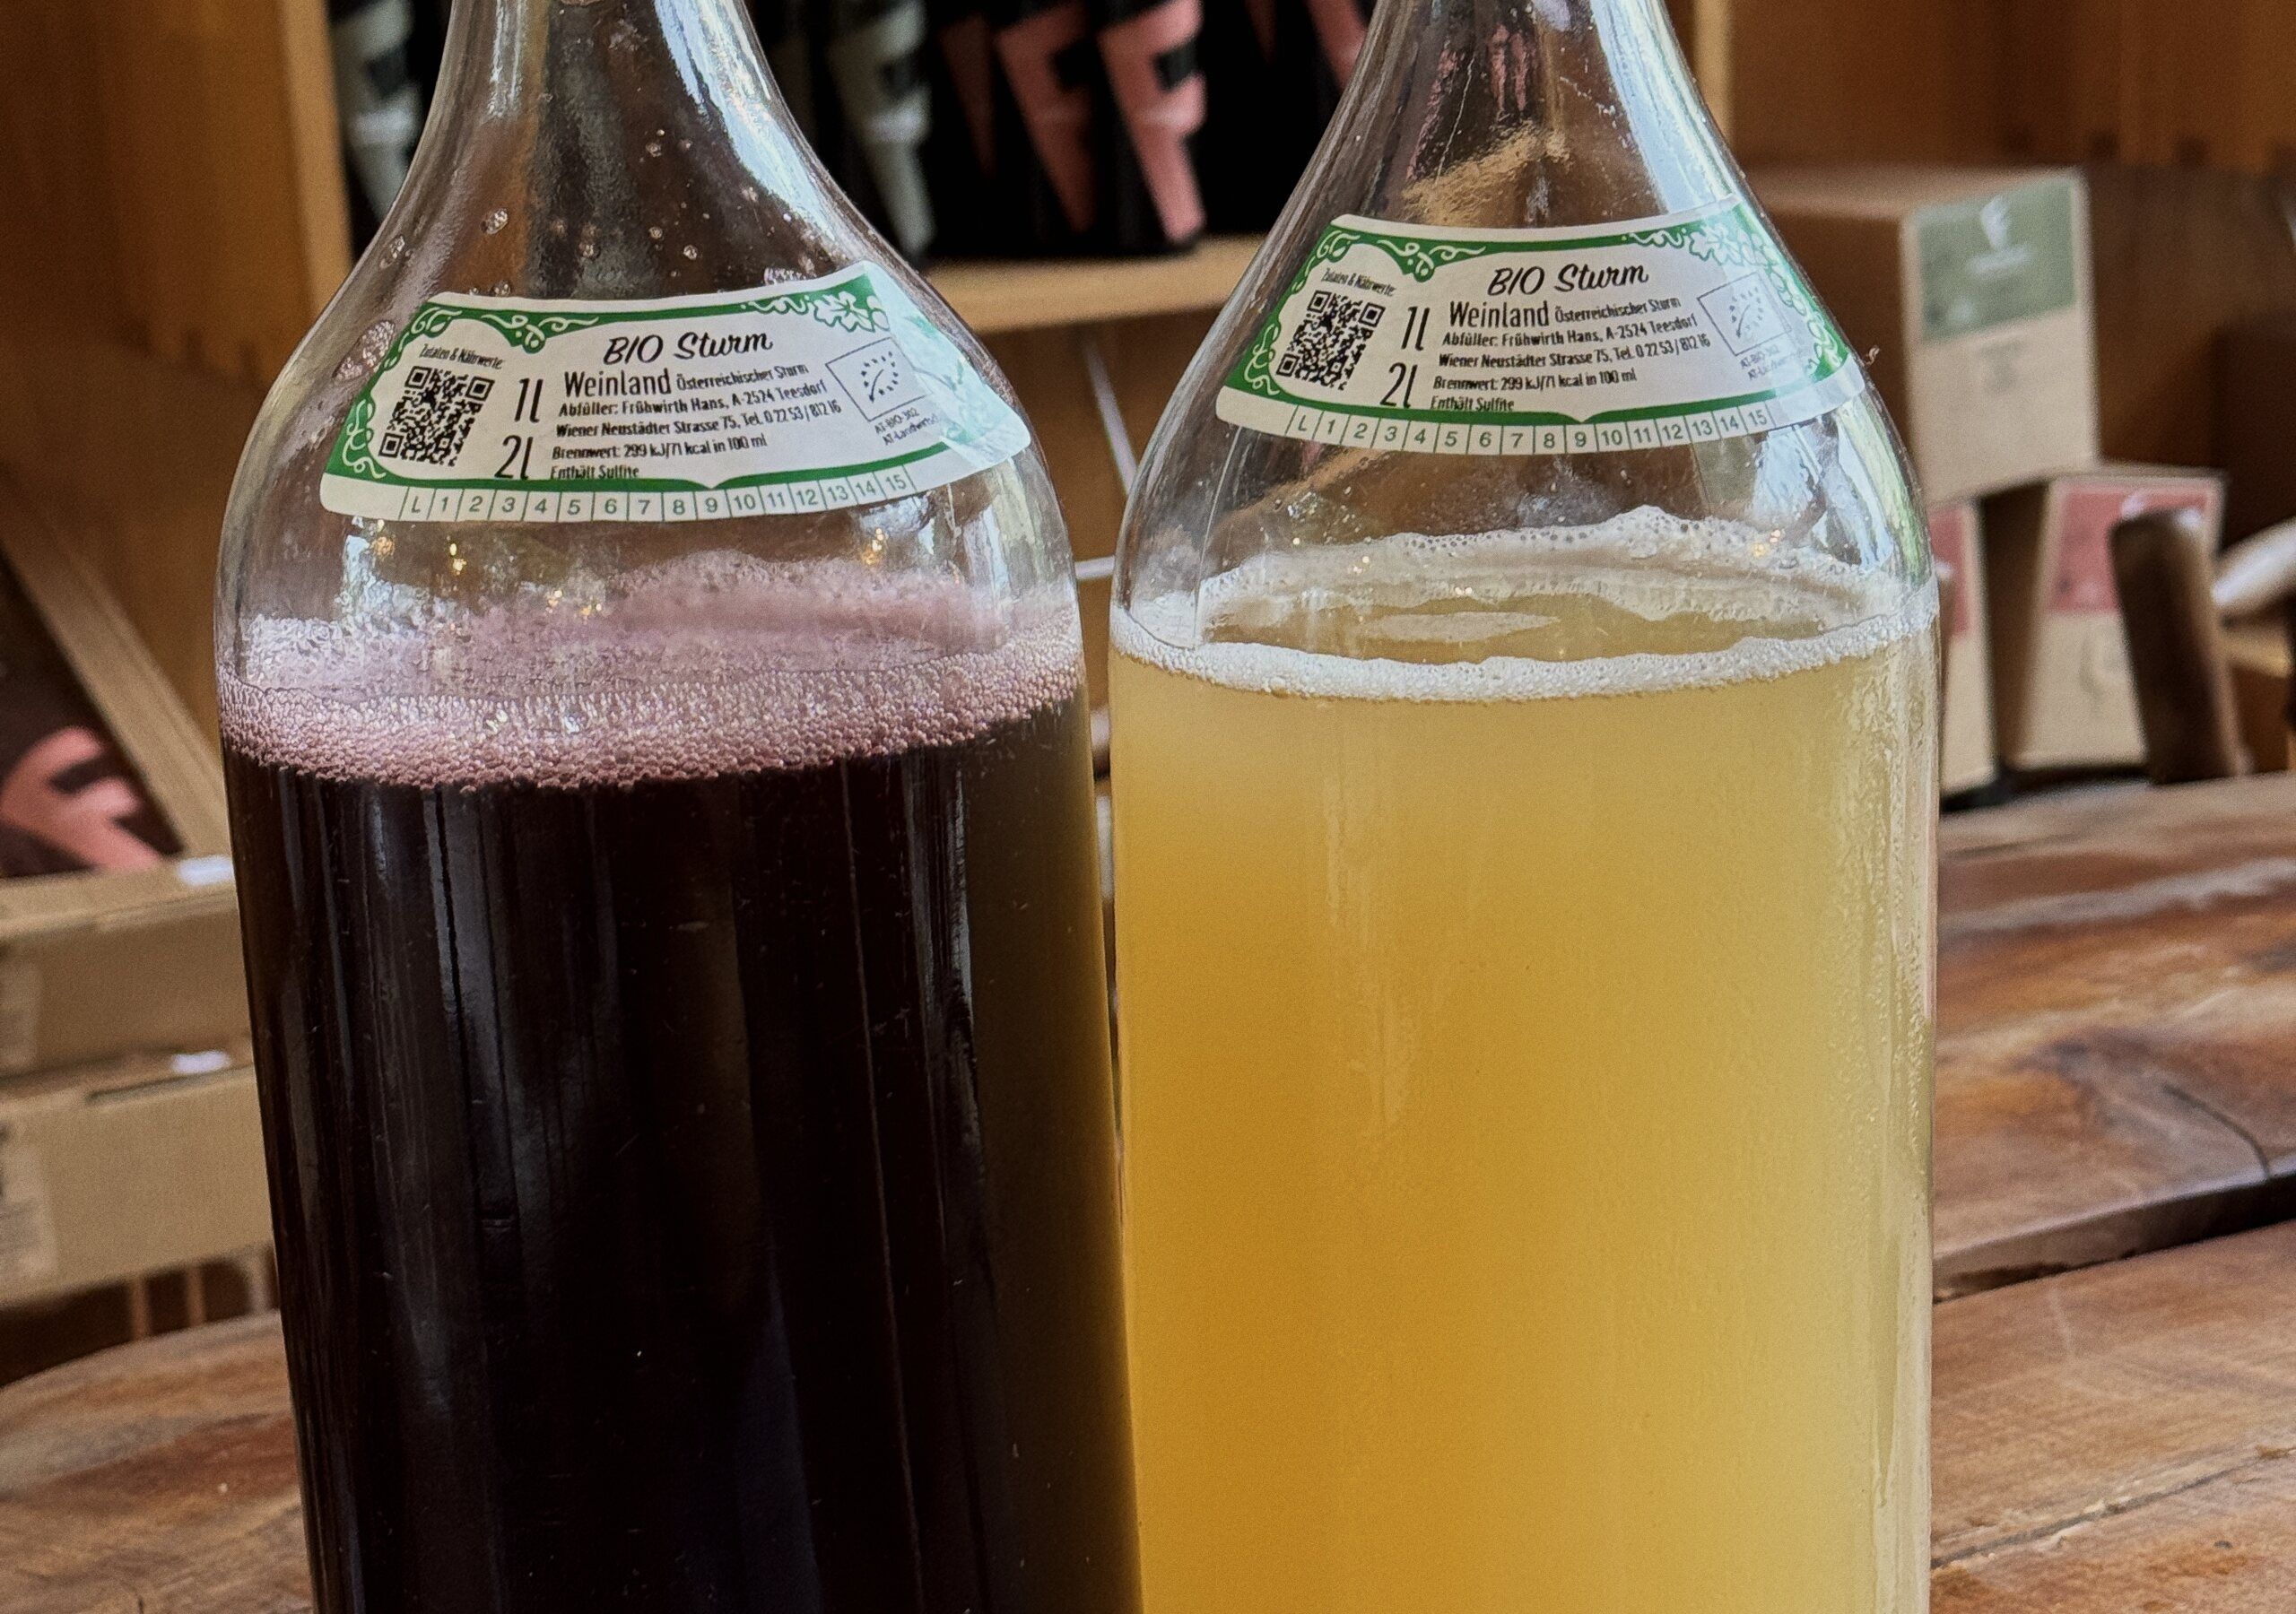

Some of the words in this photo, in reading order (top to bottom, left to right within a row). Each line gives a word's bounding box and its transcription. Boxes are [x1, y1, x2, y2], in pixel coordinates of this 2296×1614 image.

[1487, 265, 1545, 296] BIO
[1554, 263, 1649, 292] Sturm
[1449, 299, 1550, 328] Weinland
[1554, 301, 1648, 323] Österreichischer
[1648, 297, 1682, 312] Sturm
[1442, 332, 1499, 346] Abfüller:
[1501, 331, 1564, 347] Frühwirth
[1567, 329, 1604, 344] Hans,
[1648, 313, 1699, 334] Teesdorf
[449, 348, 459, 360] &
[603, 334, 664, 365] BIO
[674, 332, 773, 360] Sturm
[1439, 352, 1479, 368] Wiener
[1481, 353, 1546, 369] Neustädter
[1548, 352, 1593, 367] Strasse
[564, 368, 672, 398] Weinland
[676, 369, 774, 391] Österreichischer
[774, 364, 809, 379] Sturm
[1500, 377, 1523, 391] 299
[1558, 373, 1583, 388] kcal
[1586, 372, 1596, 386] in
[1599, 369, 1619, 384] 100
[1622, 368, 1637, 382] ml
[559, 402, 619, 417] Abfüller:
[622, 399, 687, 415] Frühwirth
[691, 397, 729, 412] Hans,
[776, 378, 828, 401] Teesdorf
[1431, 395, 1474, 411] Enthält
[1475, 396, 1515, 412] Sulfite
[556, 423, 598, 438] Wiener
[601, 421, 671, 437] Neustädter
[674, 420, 719, 434] Strasse
[1298, 415, 1307, 432] L
[1327, 419, 1336, 435] 1
[1353, 423, 1368, 439] 2
[1384, 426, 1397, 442] 3
[1414, 429, 1426, 444] 4
[1444, 431, 1458, 447] 5
[1480, 431, 1492, 447] 6
[1510, 433, 1524, 448] 7
[1543, 432, 1555, 448] 8
[1574, 431, 1587, 447] 9
[1601, 430, 1622, 446] 10
[1635, 428, 1651, 443] 11
[1662, 424, 1683, 440] 12
[1692, 420, 1712, 436] 13
[1718, 415, 1739, 431] 14
[1749, 409, 1768, 427] 15
[623, 444, 648, 458] 299
[684, 440, 711, 456] kcal
[713, 439, 726, 453] in
[727, 436, 750, 450] 100
[752, 433, 767, 447] ml
[551, 464, 596, 480] Enthält
[598, 464, 639, 479] Sulfite
[411, 495, 421, 513] L
[439, 496, 448, 512] 1
[469, 496, 483, 512] 2
[501, 497, 516, 513] 3
[535, 498, 547, 514] 4
[567, 499, 581, 515] 5
[604, 498, 617, 514] 6
[638, 499, 650, 515] 7
[673, 499, 685, 515] 8
[705, 497, 718, 513] 9
[734, 494, 756, 510] 10
[768, 491, 784, 508] 11
[800, 490, 819, 506] 12
[828, 485, 848, 501] 13
[855, 480, 875, 497] 14
[884, 473, 907, 491] 15
